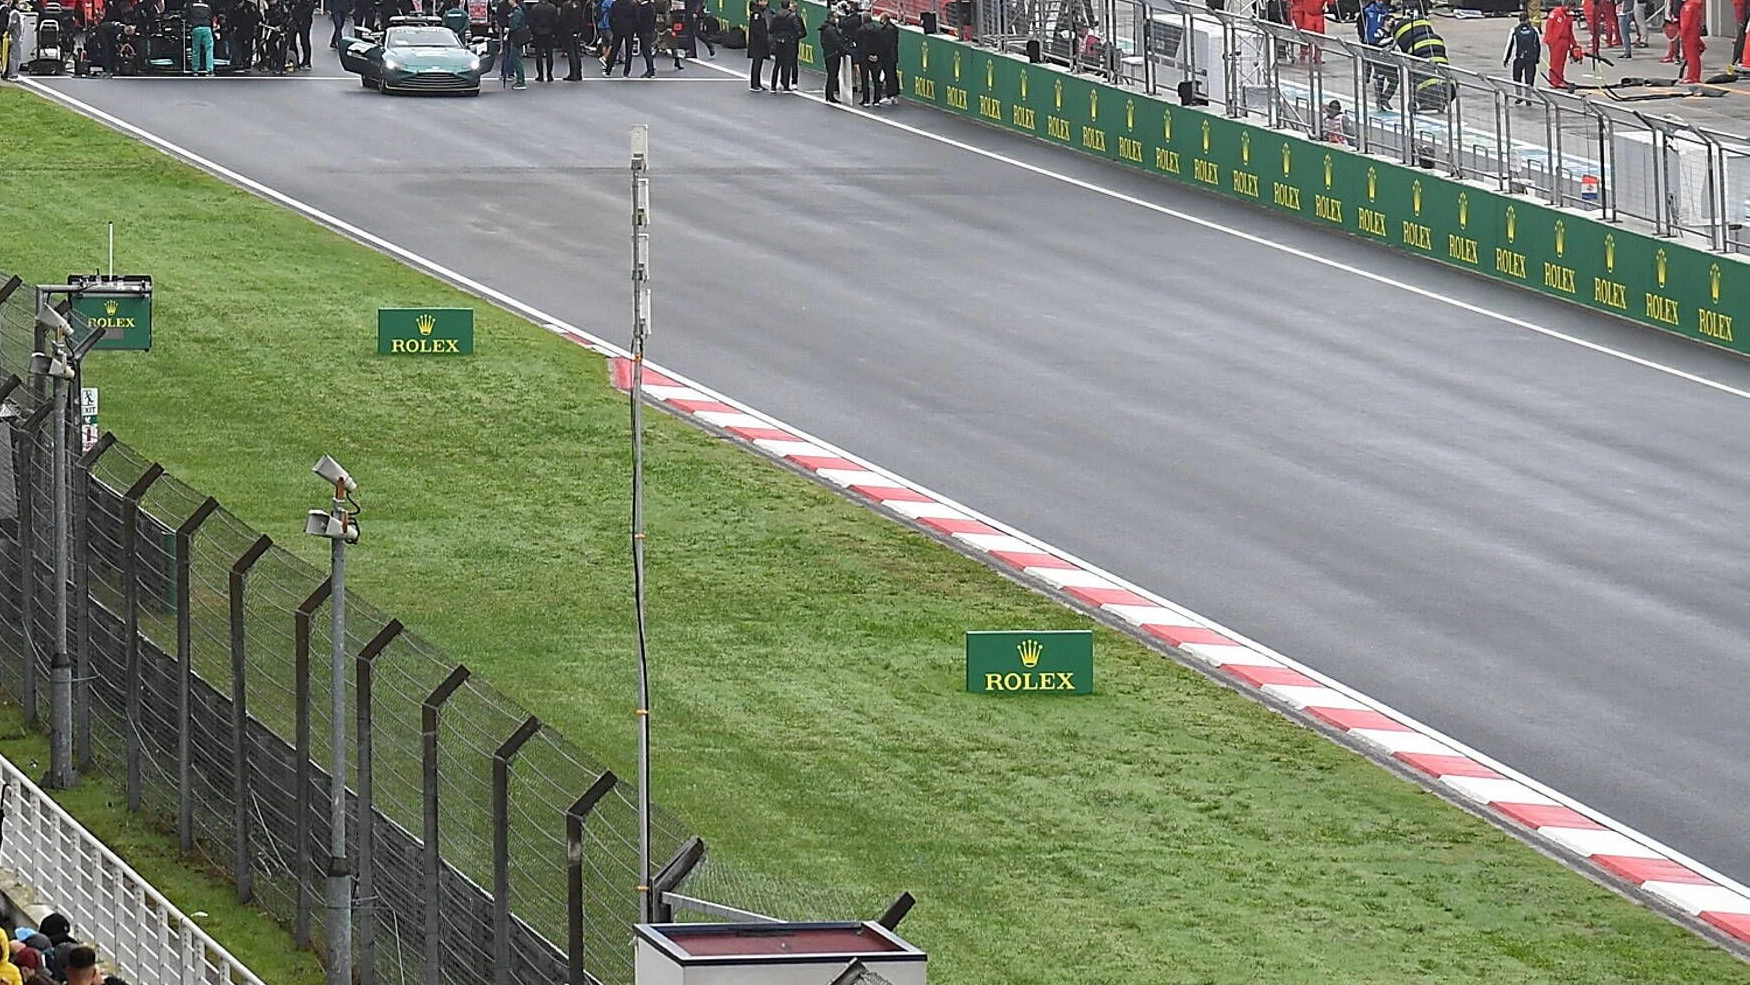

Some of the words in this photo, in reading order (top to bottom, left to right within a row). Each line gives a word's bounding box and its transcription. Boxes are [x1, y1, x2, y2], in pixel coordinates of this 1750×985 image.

[914, 76, 935, 99] ROLEX
[946, 86, 968, 109] ROLEX
[979, 96, 1002, 119] ROLEX
[1013, 105, 1036, 130] ROLEX
[1047, 116, 1071, 141] ROLEX
[1082, 126, 1106, 151] ROLEX
[1118, 137, 1143, 162] ROLEX
[1156, 148, 1180, 174] ROLEX
[1193, 159, 1219, 185] ROLEX
[1233, 170, 1259, 197] ROLEX
[1273, 182, 1301, 210] ROLEX
[1315, 195, 1343, 223] ROLEX
[1358, 207, 1387, 236] ROLEX
[1402, 221, 1432, 250] ROLEX
[1448, 234, 1479, 264] ROLEX
[1495, 248, 1527, 278] ROLEX
[1544, 262, 1577, 293] ROLEX
[1594, 277, 1627, 309] ROLEX
[1645, 293, 1679, 325] ROLEX
[88, 318, 135, 328] ROLEX
[1698, 309, 1733, 341] ROLEX
[391, 338, 460, 353] ROLEX
[985, 672, 1076, 691] ROLEX
